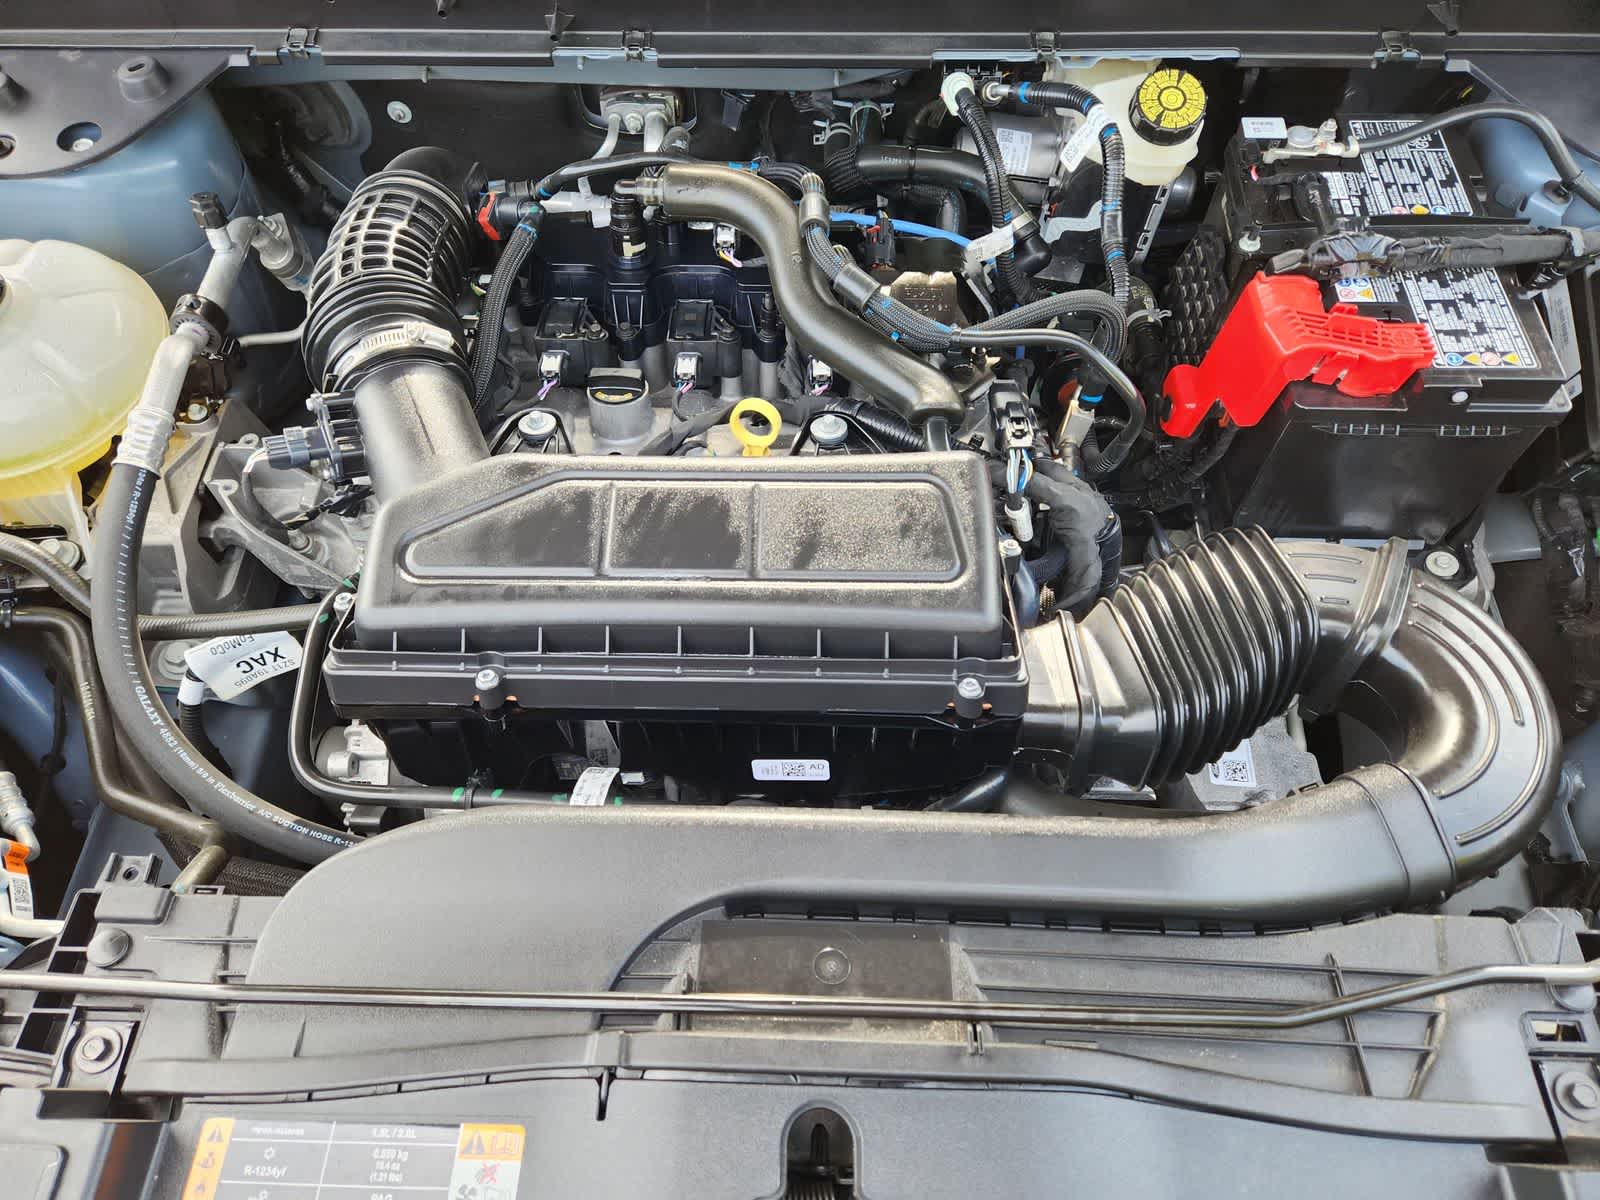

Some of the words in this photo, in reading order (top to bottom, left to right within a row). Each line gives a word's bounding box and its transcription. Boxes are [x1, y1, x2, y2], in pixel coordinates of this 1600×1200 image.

[236, 646, 286, 674] XAC
[135, 685, 164, 726] GALAXY
[271, 815, 309, 835] SUCTION
[309, 829, 334, 843] HOSE
[243, 1165, 288, 1179] R-1234yf
